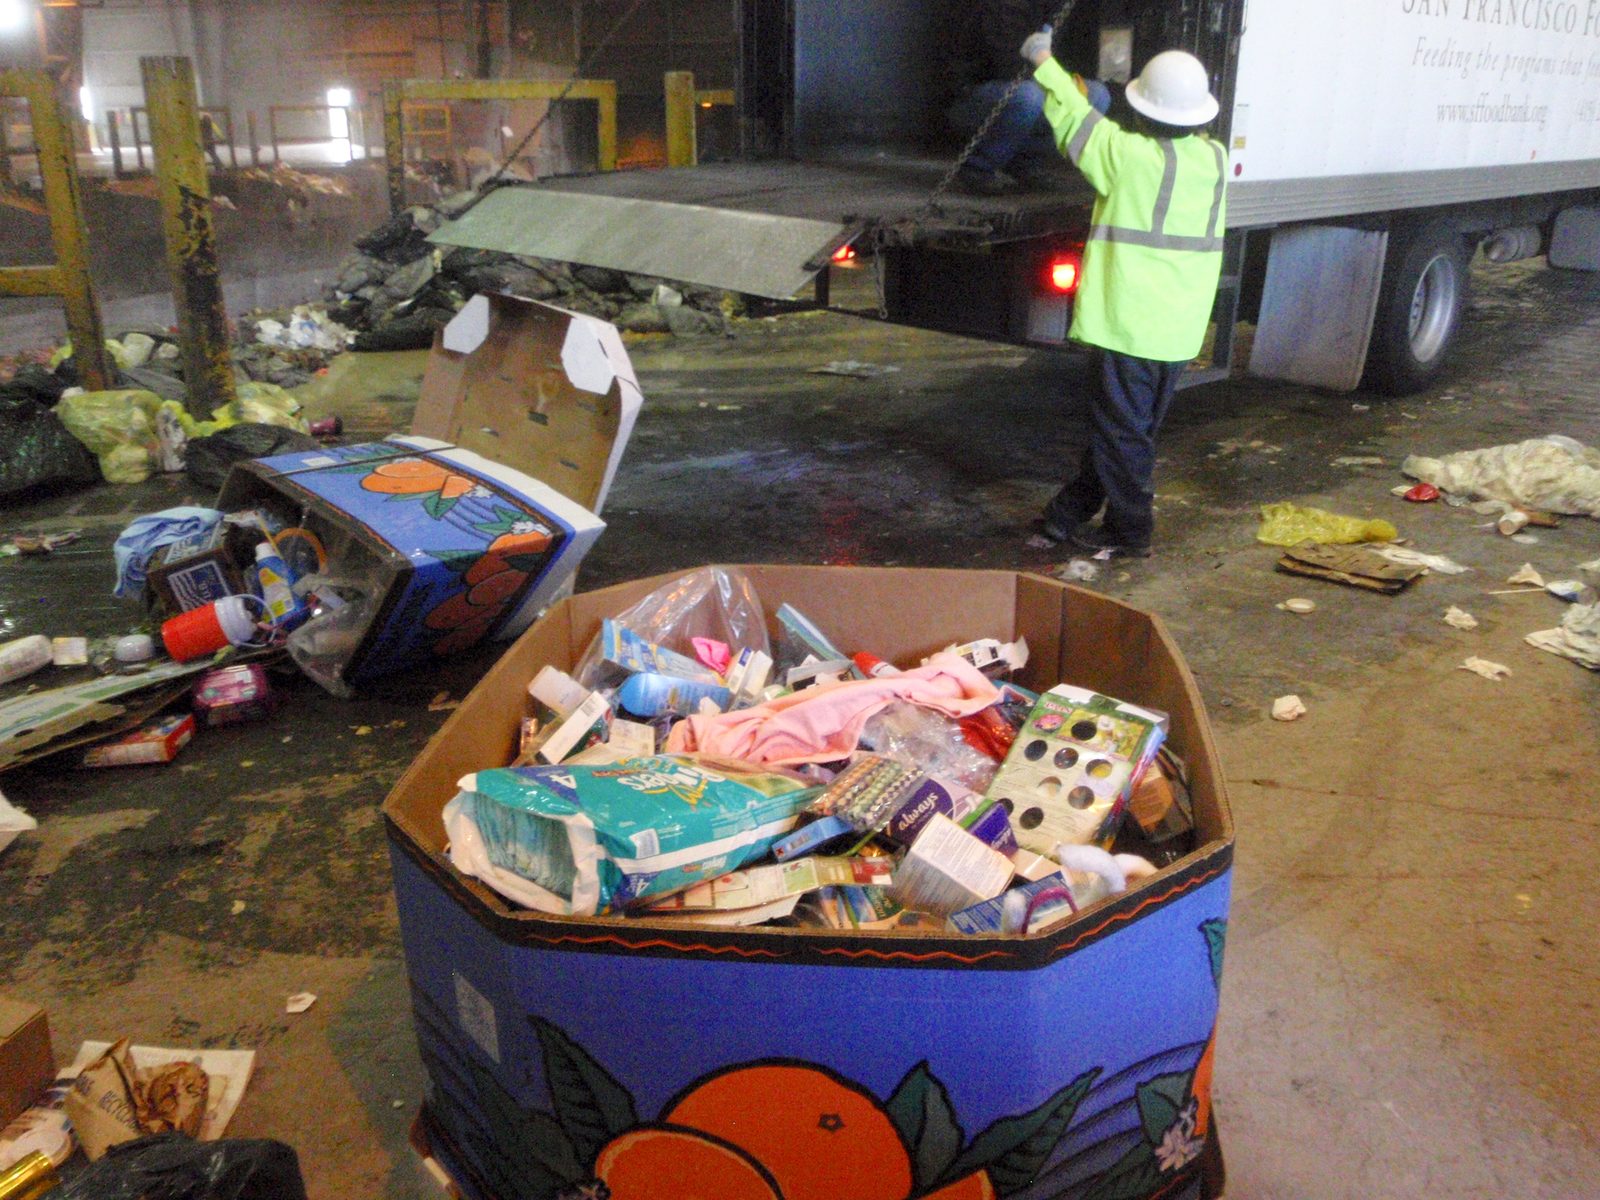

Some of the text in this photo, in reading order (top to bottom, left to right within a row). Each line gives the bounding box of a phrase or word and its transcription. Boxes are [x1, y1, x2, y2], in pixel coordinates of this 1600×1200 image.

[1412, 35, 1472, 79] Feeding
[1474, 41, 1500, 70] the
[1499, 53, 1557, 83] programs
[1437, 91, 1549, 132] www.sffoodbank.org
[897, 791, 940, 832] always
